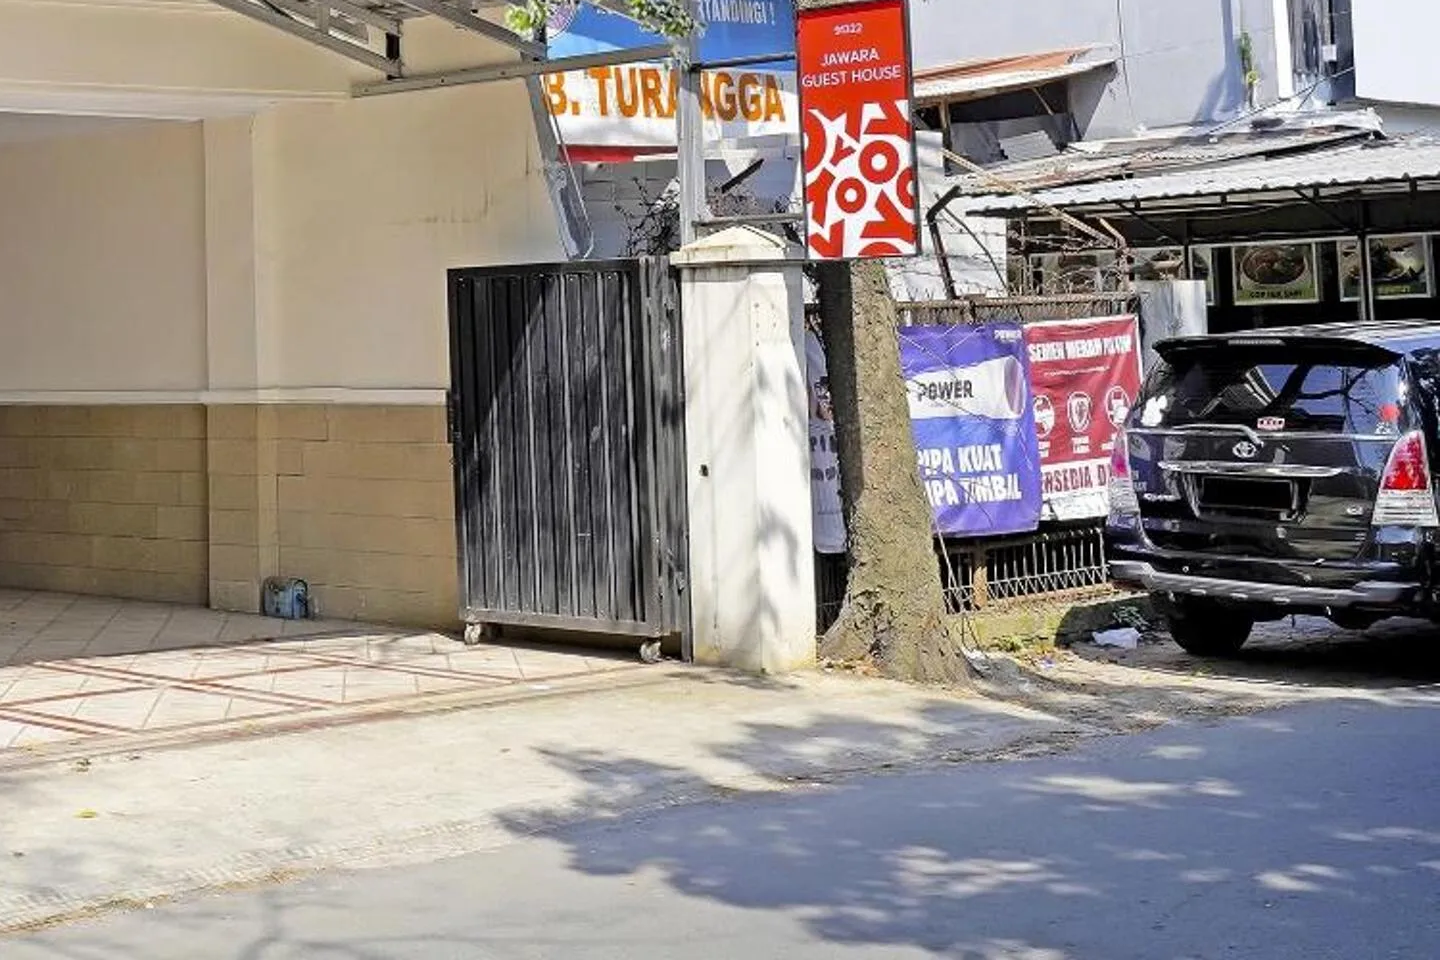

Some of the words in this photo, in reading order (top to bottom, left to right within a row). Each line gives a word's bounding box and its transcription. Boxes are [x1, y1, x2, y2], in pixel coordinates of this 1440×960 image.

[820, 47, 880, 67] JAWARA
[801, 71, 848, 87] GUEST
[851, 64, 901, 83] HOUSE
[917, 380, 973, 401] POWER
[957, 444, 1003, 473] KUAT
[1042, 464, 1094, 494] RSEDIA
